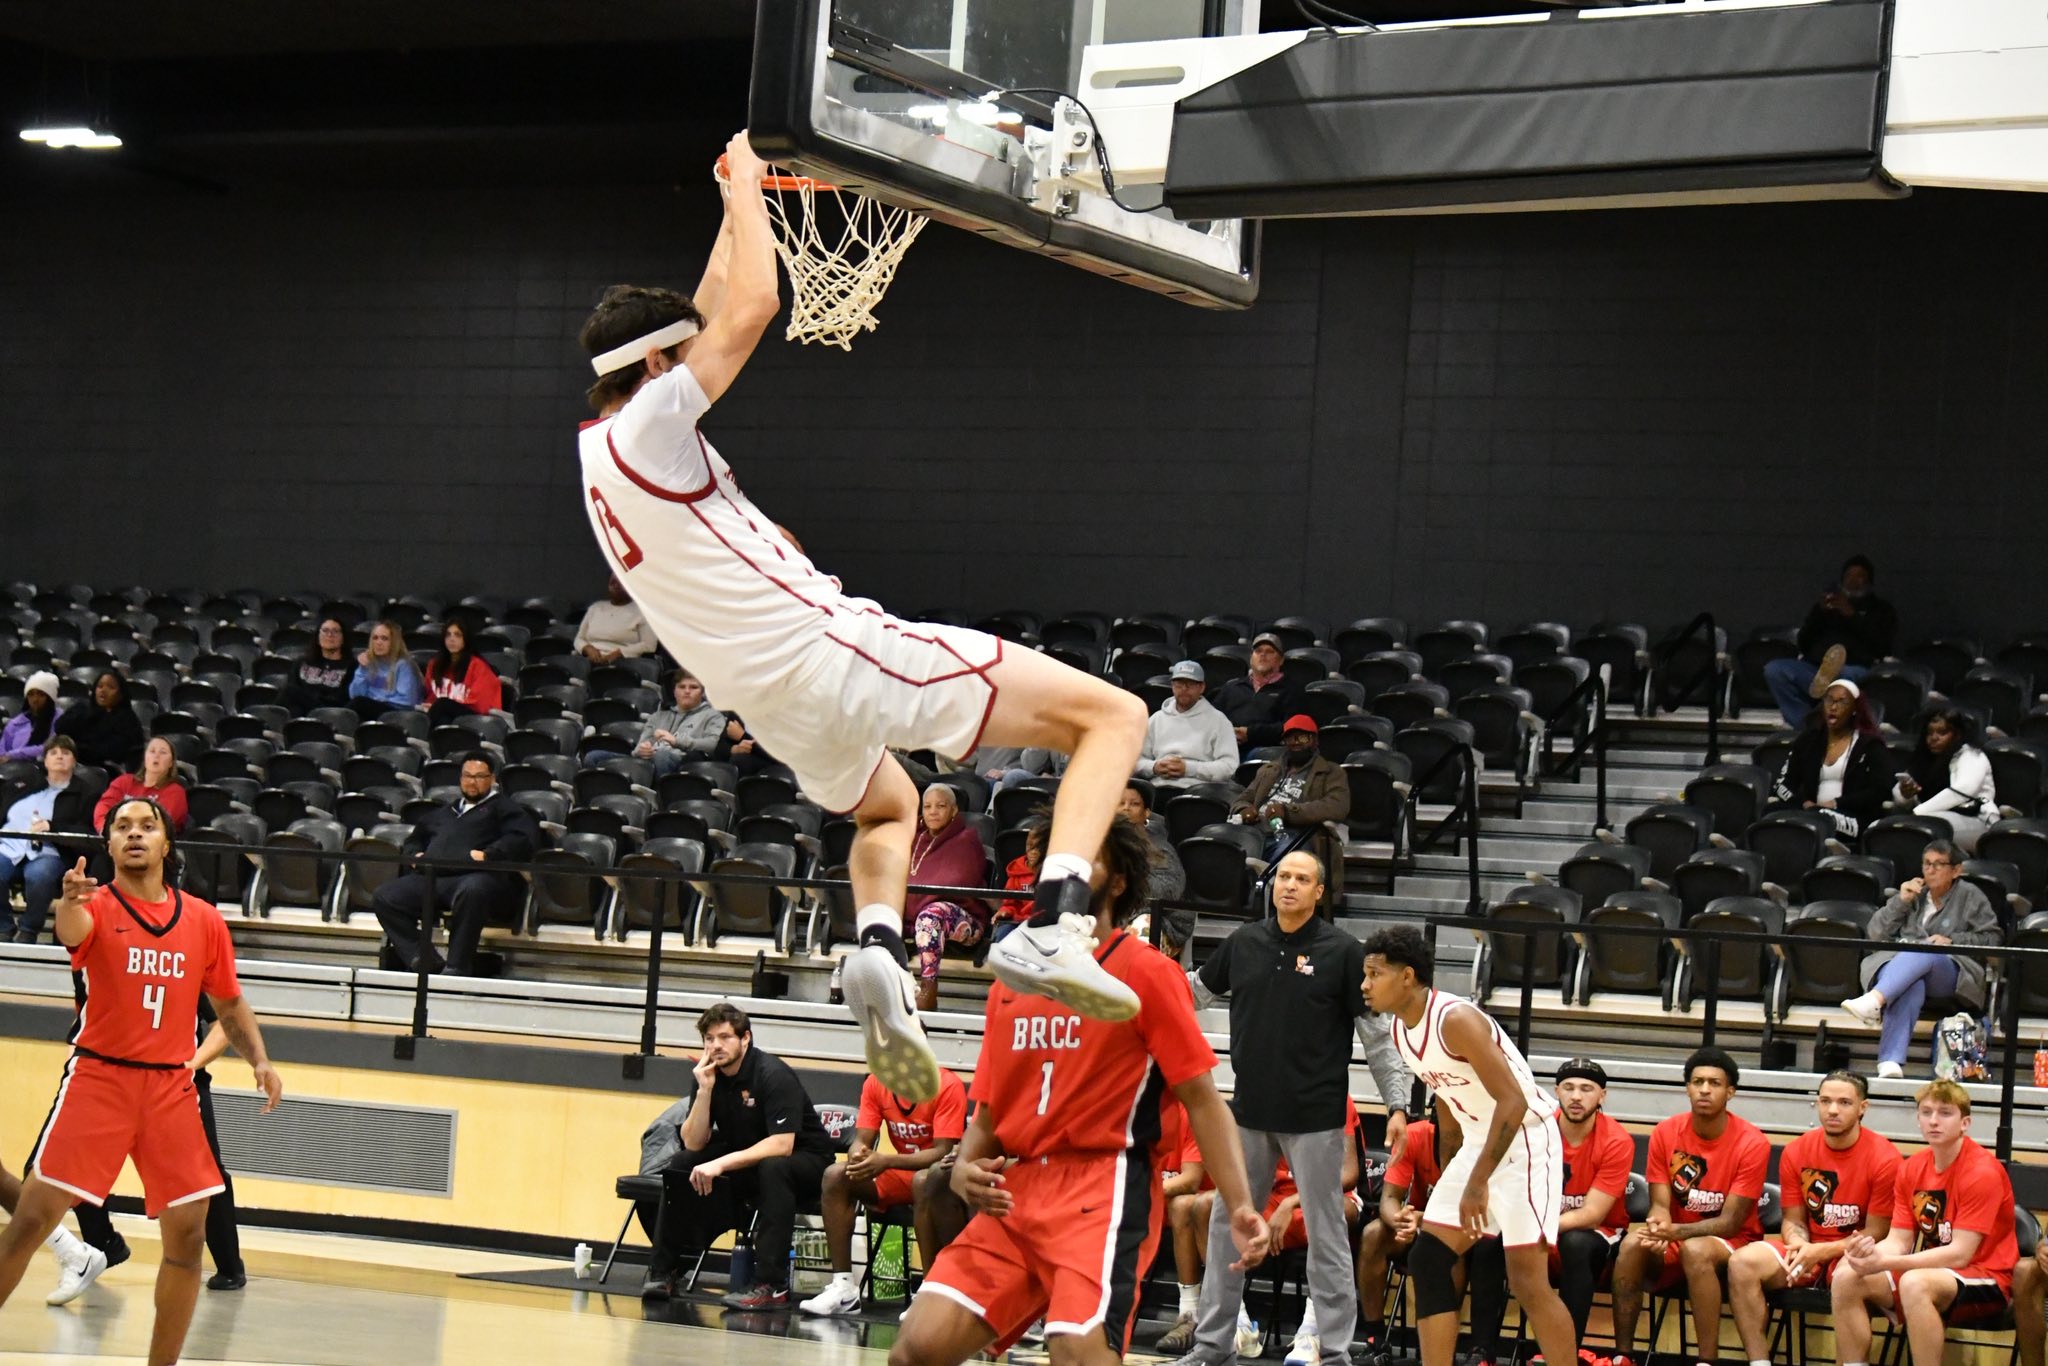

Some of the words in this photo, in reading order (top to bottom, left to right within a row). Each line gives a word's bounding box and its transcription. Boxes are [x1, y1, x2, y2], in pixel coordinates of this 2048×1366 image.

[126, 946, 186, 979] BRCC
[142, 983, 166, 1030] 4
[1011, 1015, 1081, 1051] BRCC
[1037, 1061, 1054, 1116] 1
[889, 1120, 930, 1139] BRCC
[1823, 1203, 1860, 1218] BRCC
